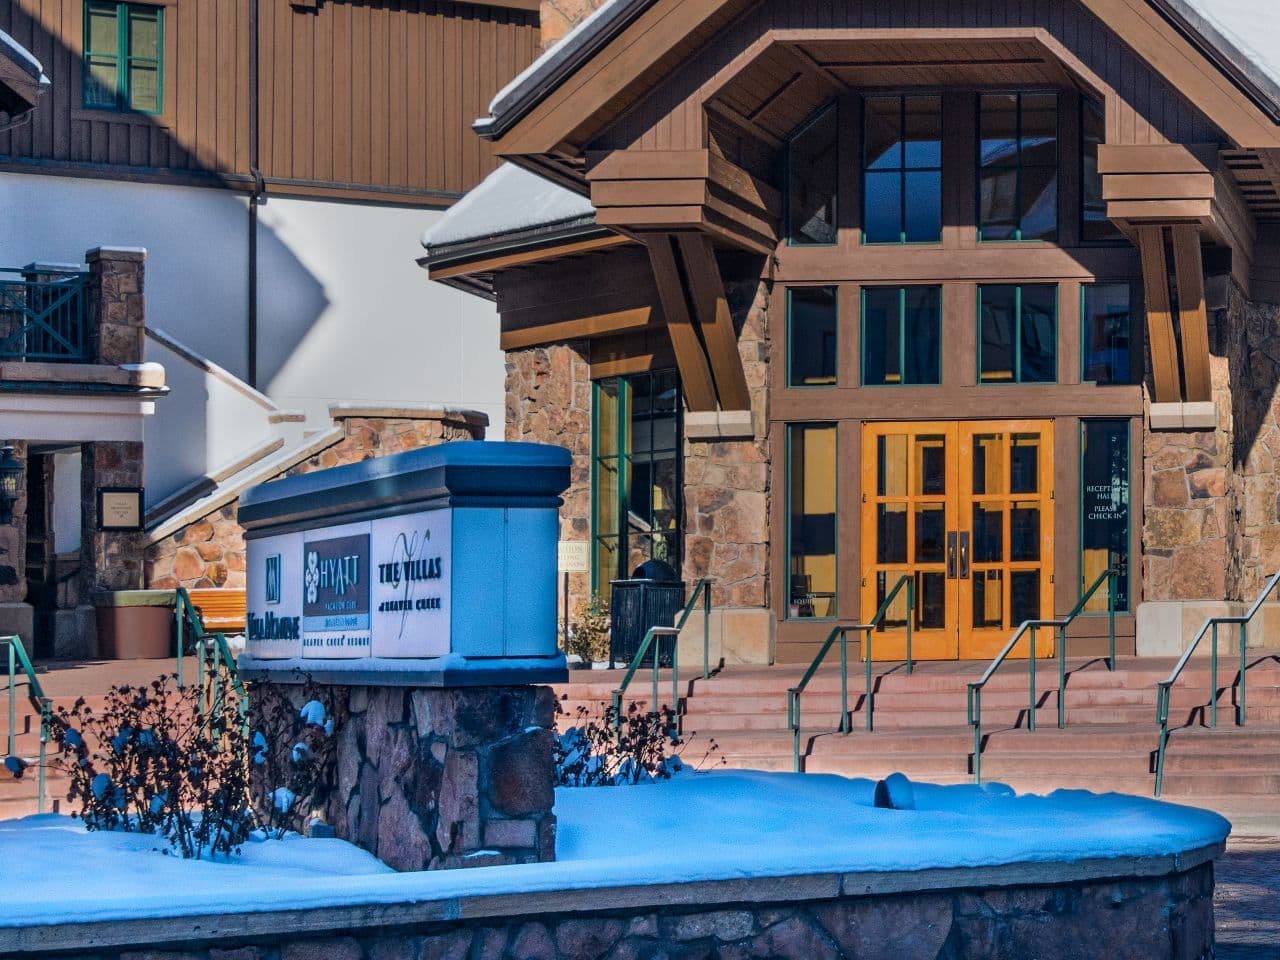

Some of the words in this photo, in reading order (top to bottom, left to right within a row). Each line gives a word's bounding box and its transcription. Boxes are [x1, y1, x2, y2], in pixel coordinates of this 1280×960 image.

[320, 555, 359, 595] HYATT
[378, 562, 401, 584] THE
[403, 557, 442, 582] VILLAS
[416, 598, 441, 611] CREEK
